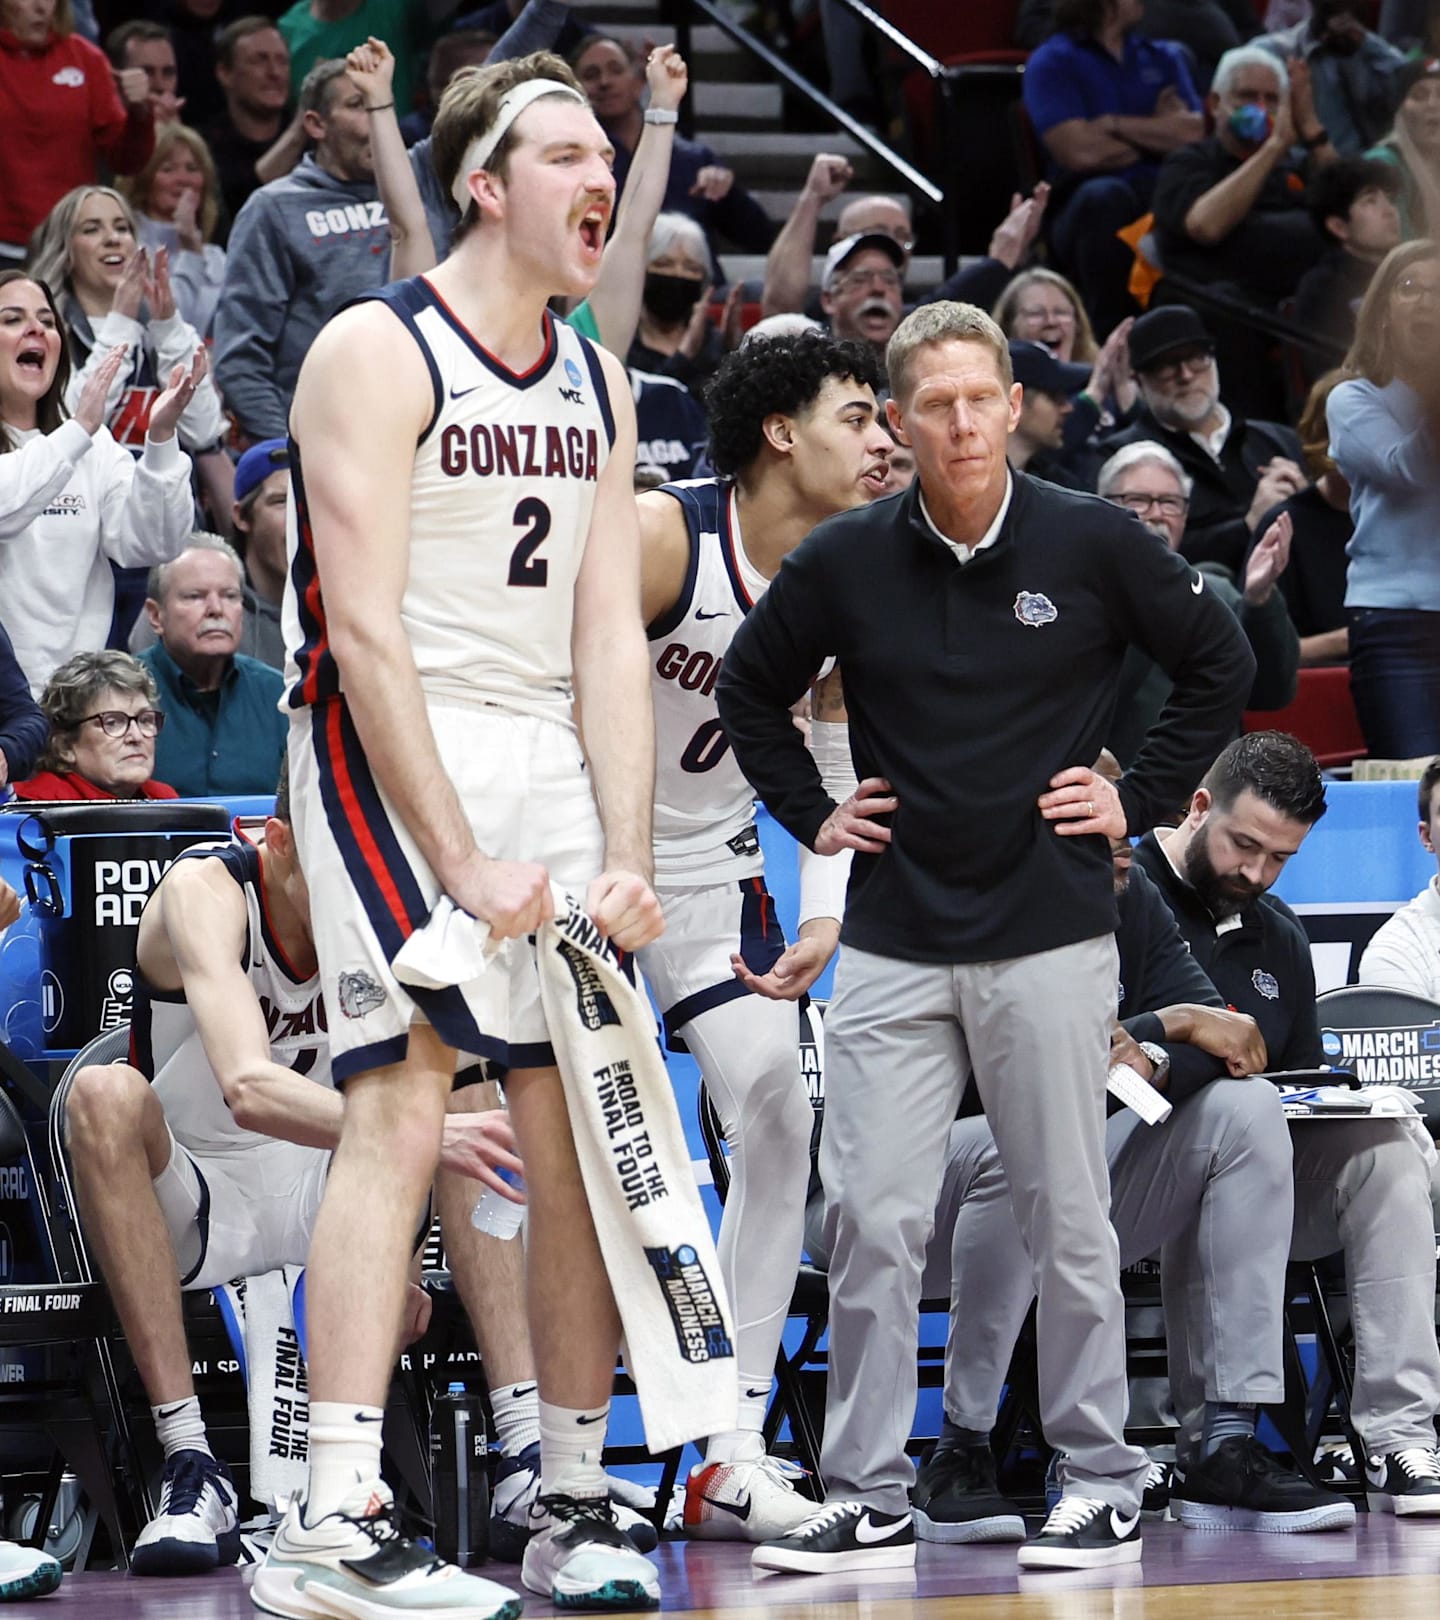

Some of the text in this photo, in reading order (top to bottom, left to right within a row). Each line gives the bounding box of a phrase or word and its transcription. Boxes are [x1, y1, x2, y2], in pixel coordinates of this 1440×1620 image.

[441, 424, 598, 482] GONZAGA
[507, 496, 551, 588] 2
[1342, 1031, 1418, 1057] MARCH
[593, 1066, 651, 1213] FINAL FOUR
[611, 1060, 669, 1201] THE ROAD TO THE
[4, 1296, 42, 1313] FINAL
[45, 1294, 81, 1310] FOUR
[666, 1279, 710, 1362] MADNESS
[680, 1264, 721, 1327] MARCH
[269, 1326, 299, 1458] FINAL FOUR
